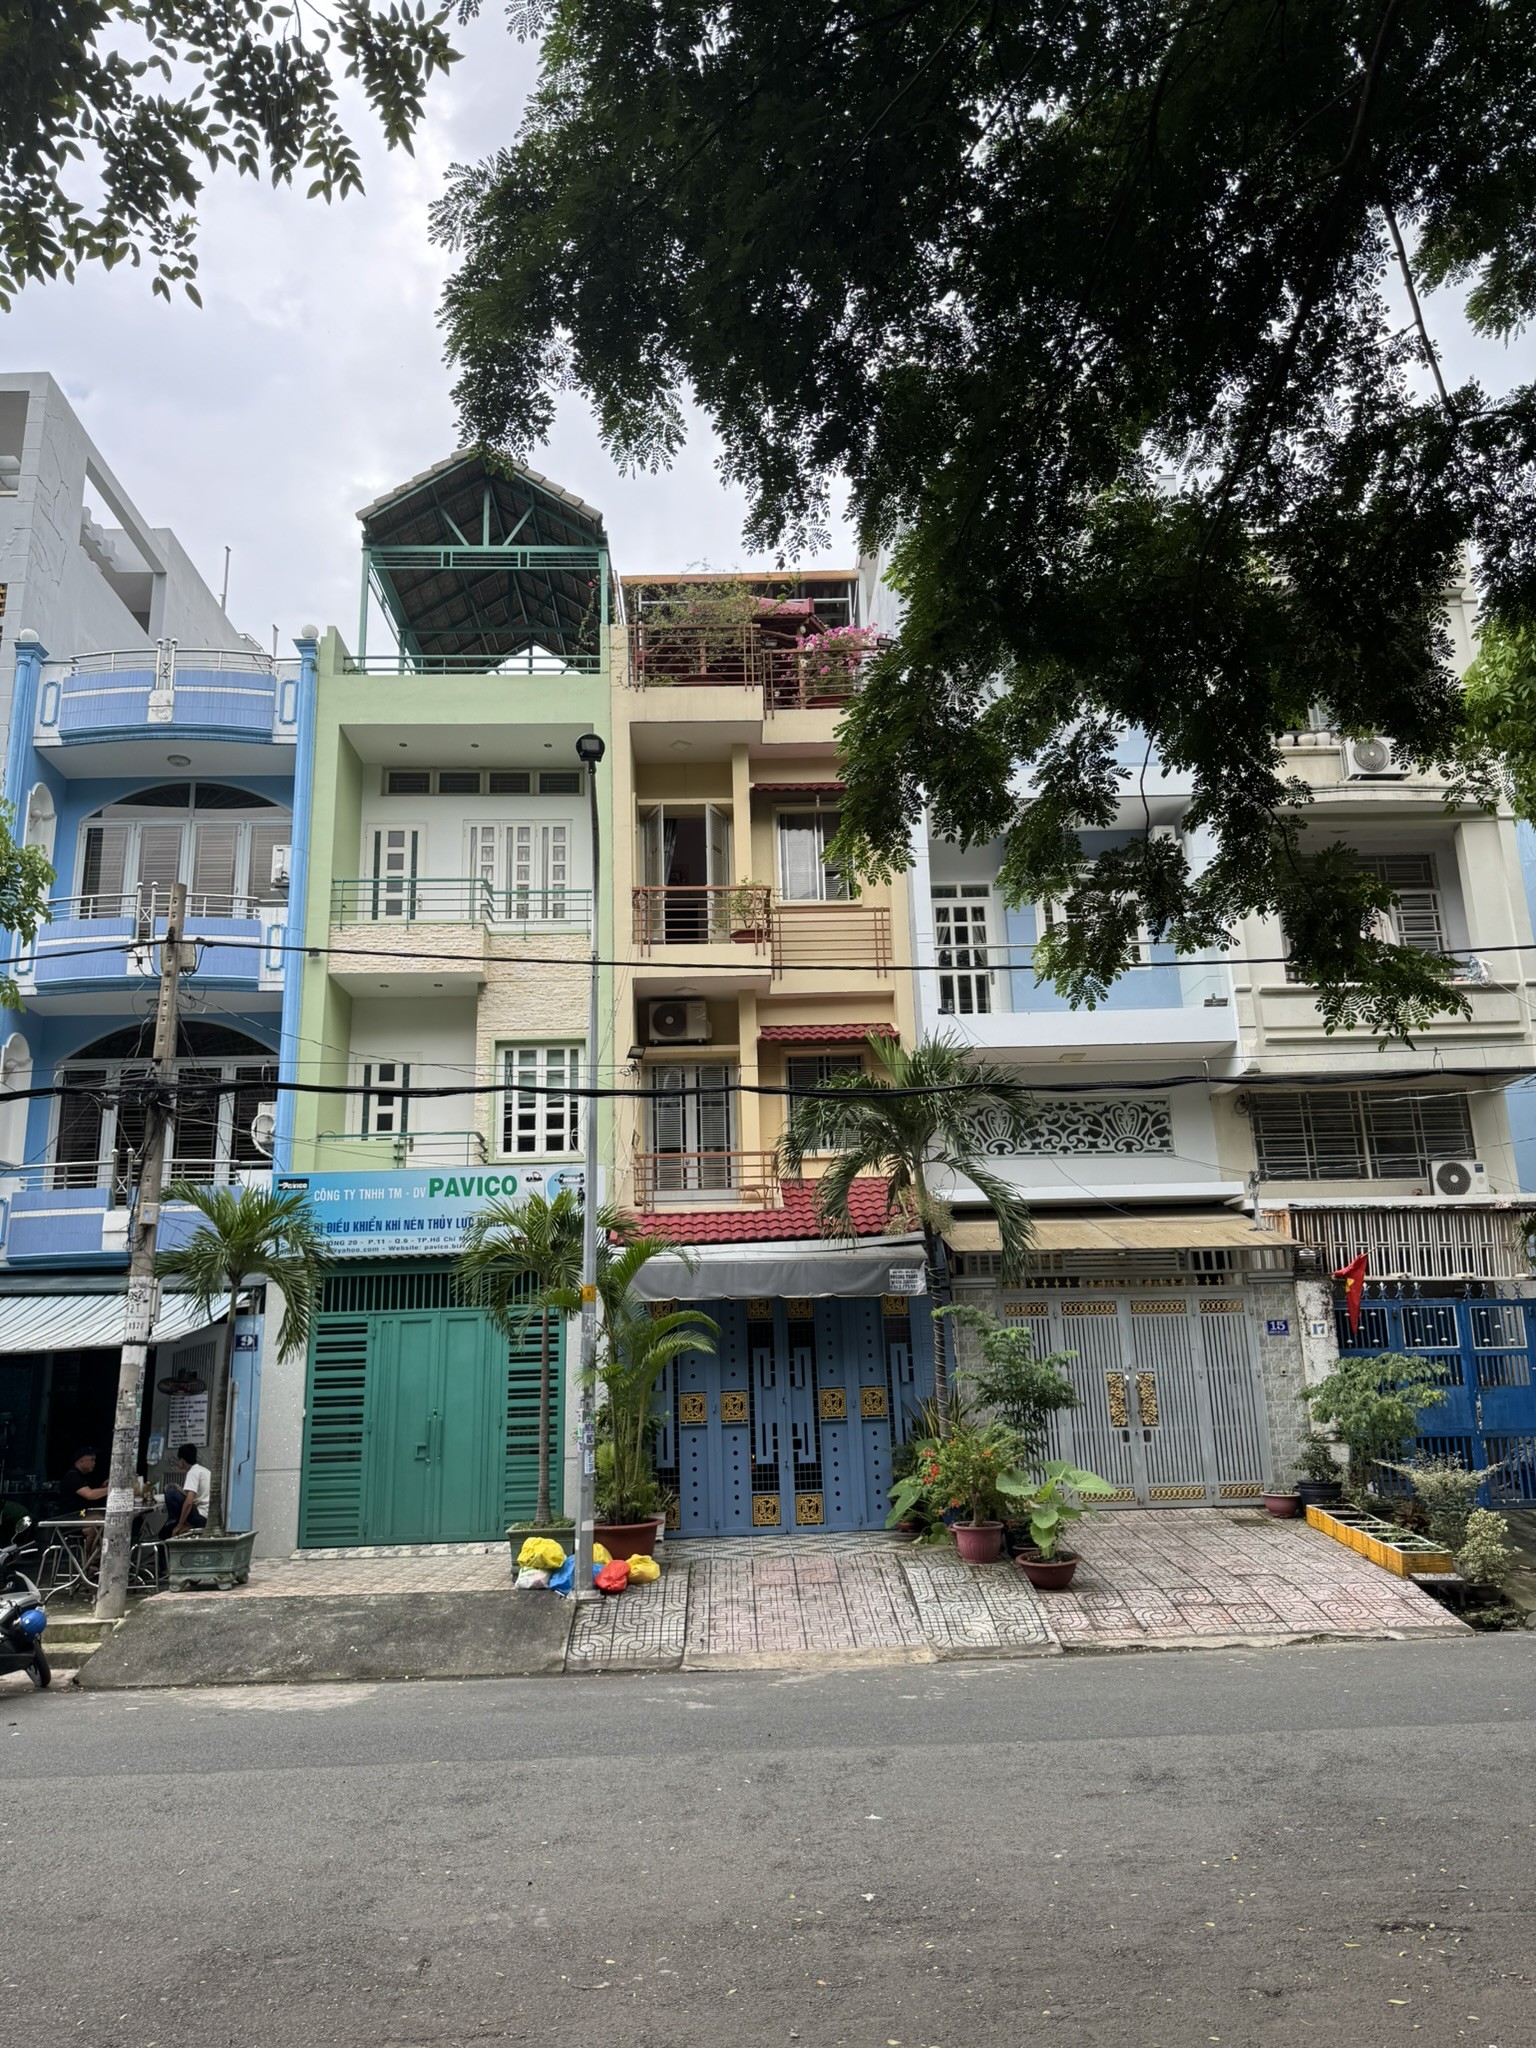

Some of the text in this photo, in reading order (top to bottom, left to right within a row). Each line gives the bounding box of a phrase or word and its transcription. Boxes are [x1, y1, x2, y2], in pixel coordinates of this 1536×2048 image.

[314, 1188, 340, 1201] CÔNG
[344, 1189, 356, 1200] TY
[359, 1188, 385, 1200] TNHH
[388, 1187, 402, 1199] TM
[429, 1175, 518, 1198] PAVICO
[353, 1216, 382, 1232] KHIỂN
[385, 1218, 401, 1231] KHÍ
[428, 1214, 453, 1230] THỦY
[1270, 1321, 1286, 1331] 15
[1312, 1323, 1326, 1335] 17
[240, 1335, 253, 1346] 9
